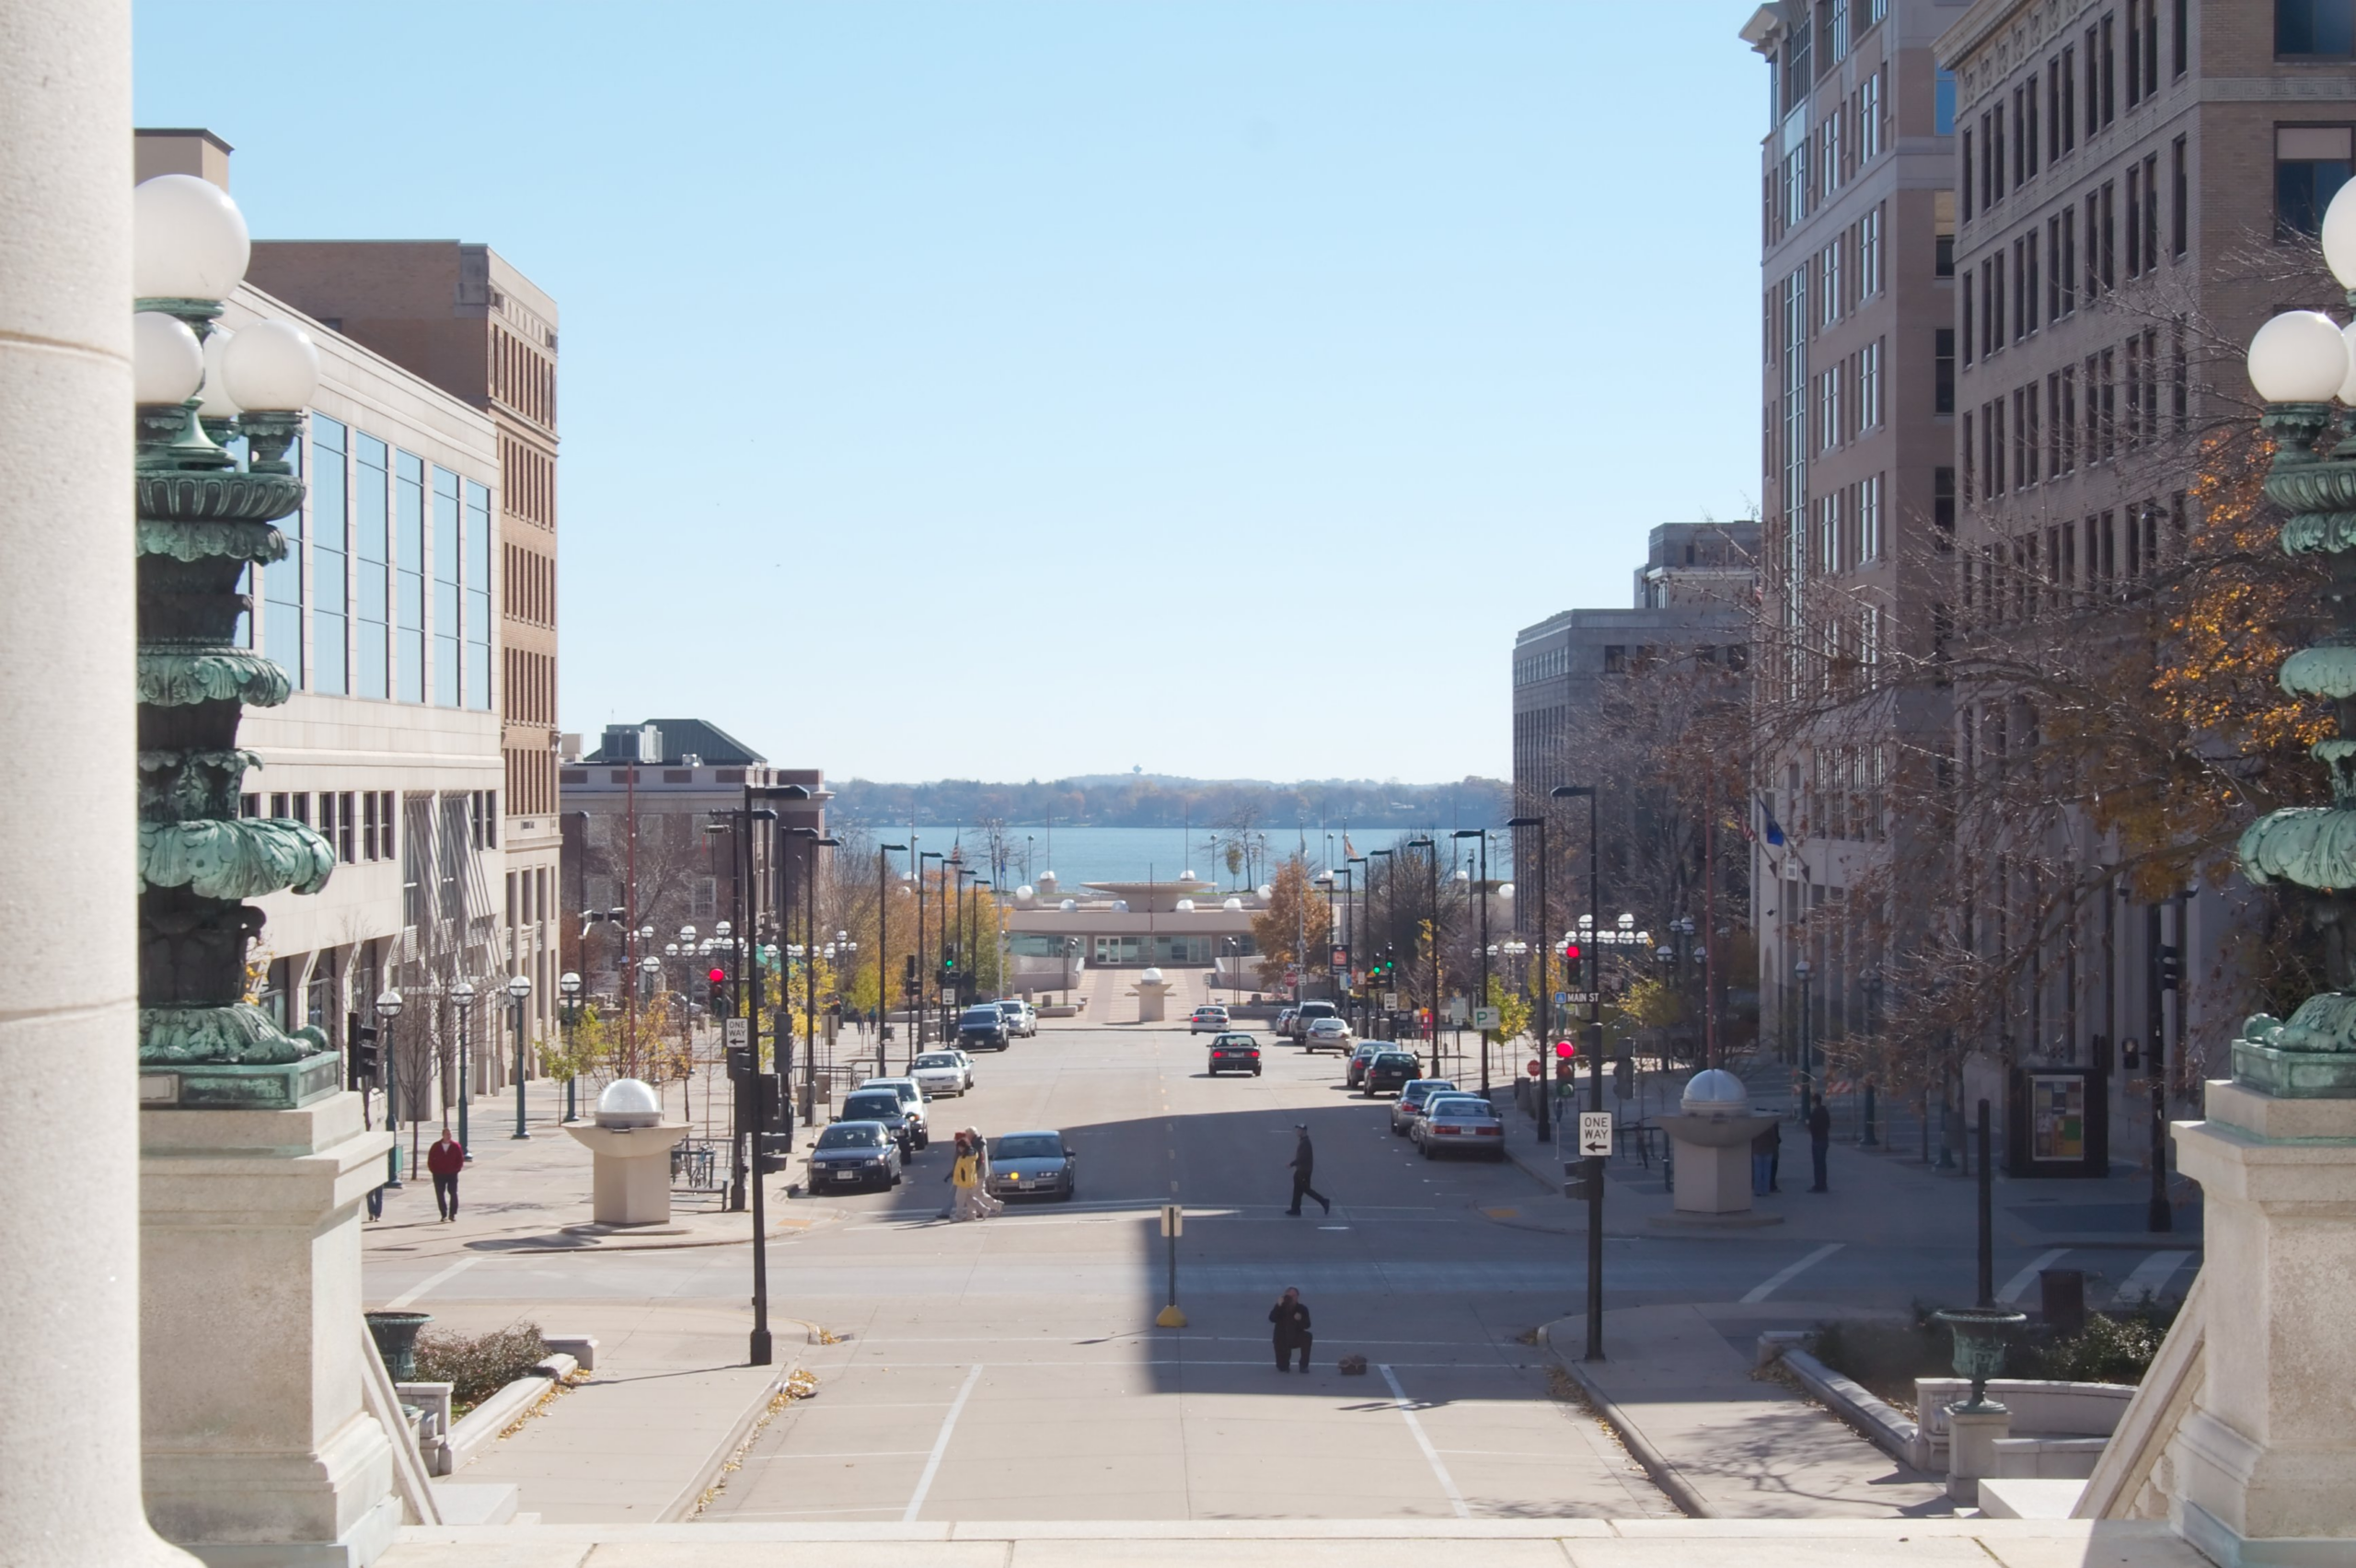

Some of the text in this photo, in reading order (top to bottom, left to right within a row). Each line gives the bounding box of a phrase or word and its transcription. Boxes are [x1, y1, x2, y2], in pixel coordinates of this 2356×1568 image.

[1567, 993, 1600, 1002] MAIN ST
[1476, 1011, 1488, 1026] P
[1584, 1116, 1608, 1128] ONE
[1584, 1129, 1609, 1140] WAY
